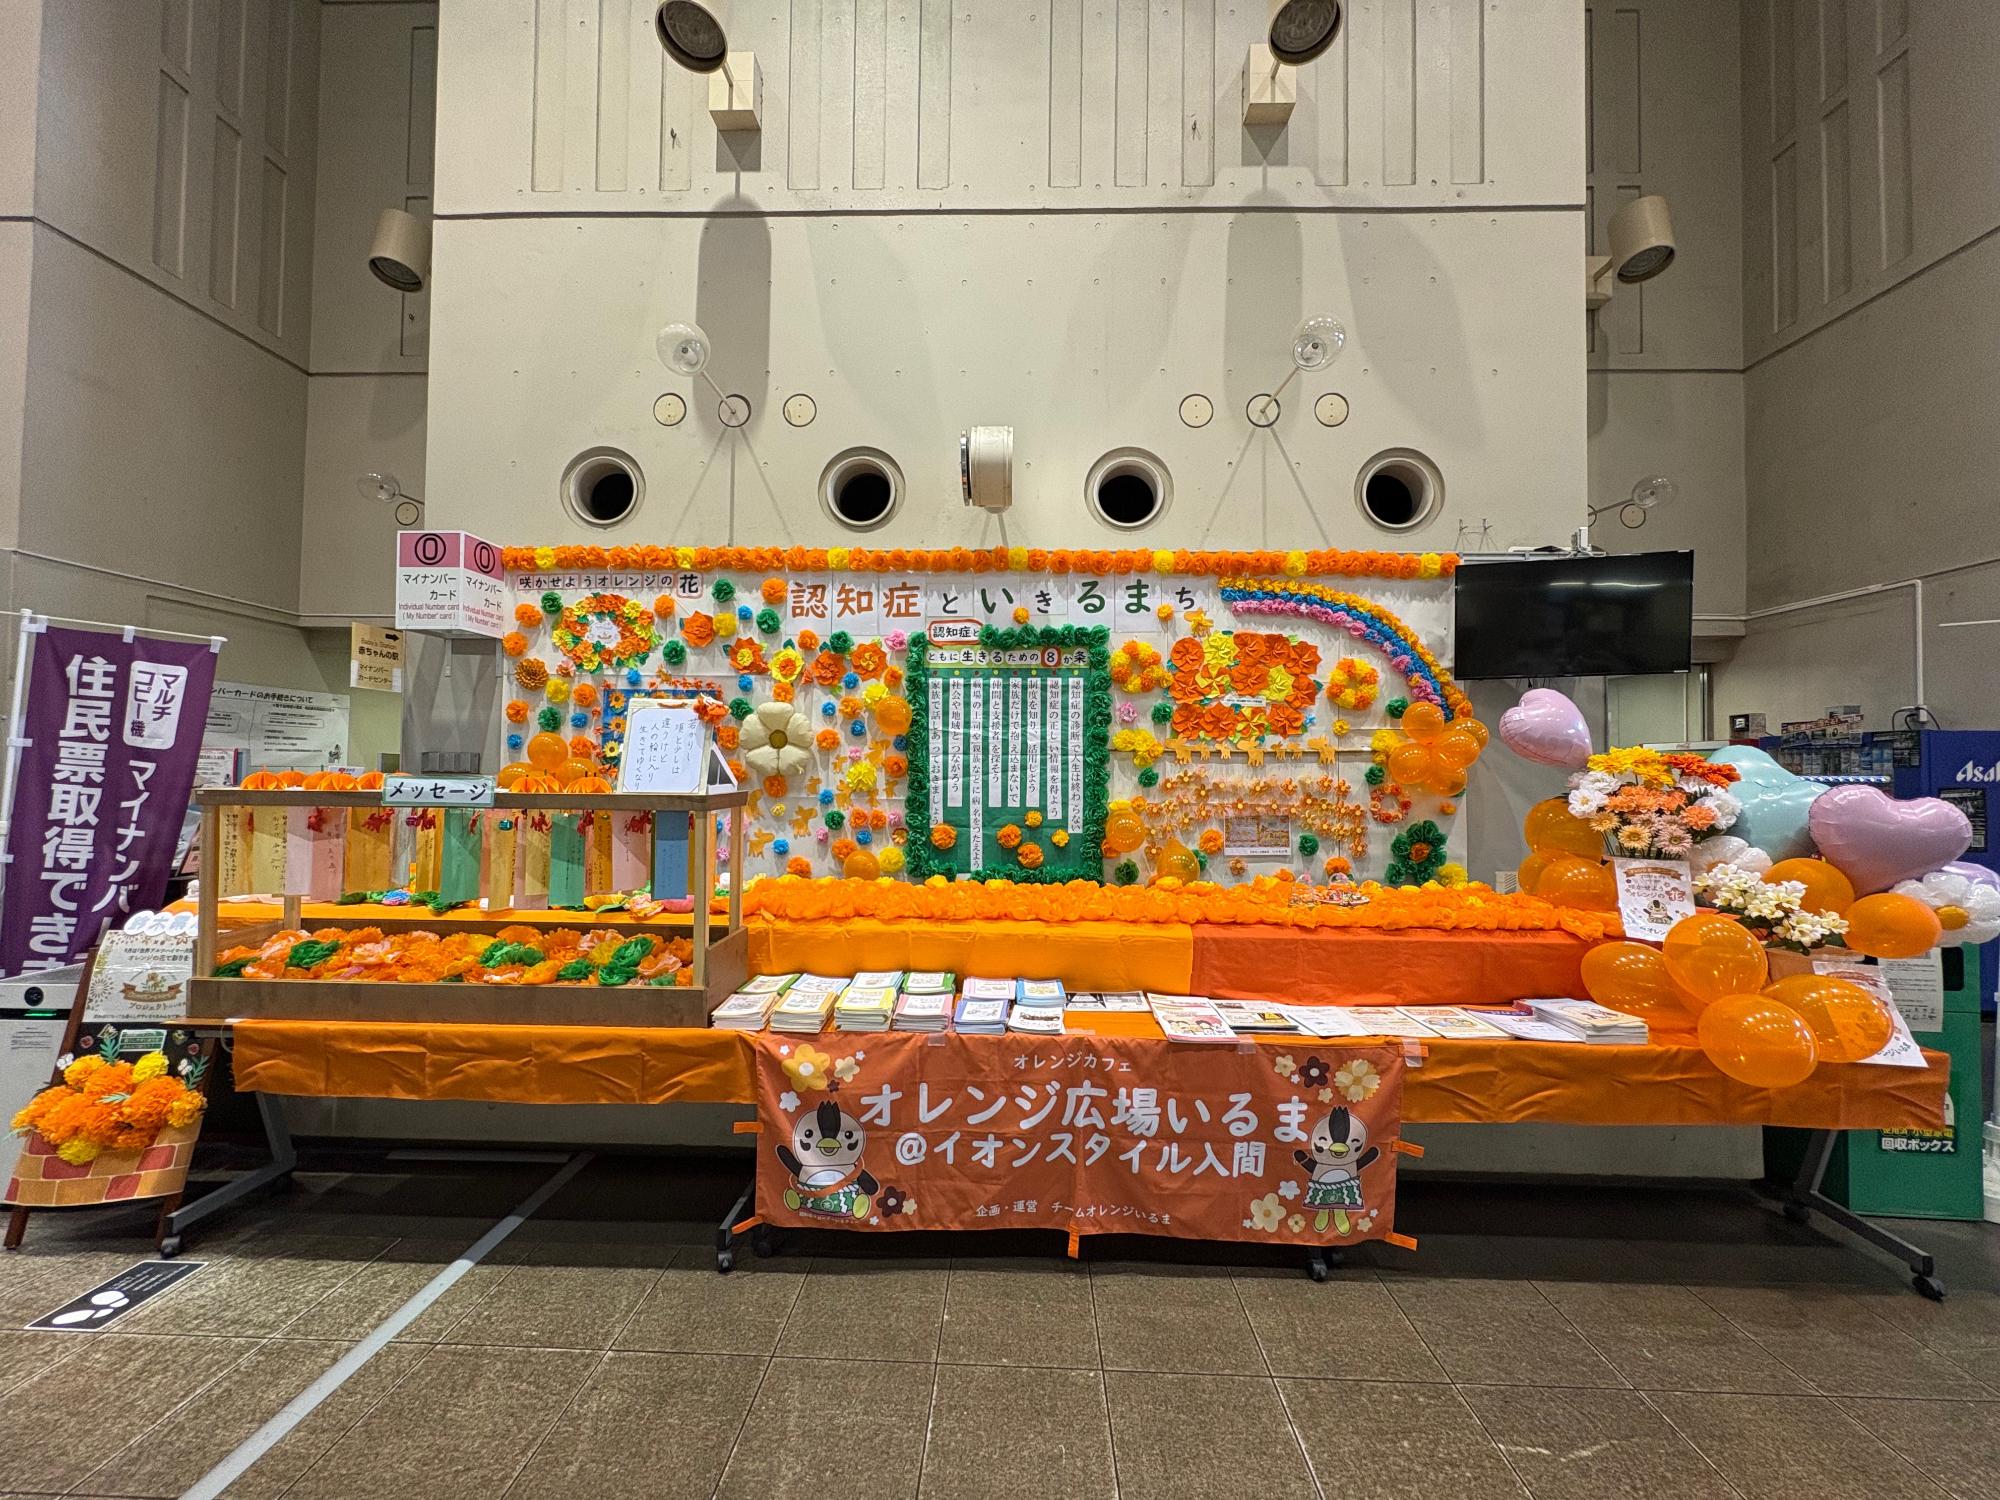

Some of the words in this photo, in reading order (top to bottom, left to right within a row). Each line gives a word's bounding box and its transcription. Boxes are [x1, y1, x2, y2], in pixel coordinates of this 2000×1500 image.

[403, 574, 457, 585] マイナンバー
[466, 576, 502, 594] マイナンバー
[519, 574, 699, 594] 咲かせようオレンジの花
[430, 590, 456, 601] カード
[484, 598, 502, 611] カード
[791, 579, 1197, 618] 認知症といきるまち
[933, 626, 978, 639] 認知症と
[359, 646, 399, 661] 赤ちゃんの駅
[928, 650, 1087, 663] ともに生きるための8か条
[130, 669, 155, 738] コピー機
[152, 673, 180, 722] マルチ
[951, 681, 962, 793] 社会や地域とつながろう
[389, 781, 488, 801] メッセージ
[1014, 1051, 1132, 1072] オレンジカフェ
[860, 1080, 1309, 1142] オレンジ広場いるま
[896, 1131, 1267, 1178] @イオンスタイル入間
[1881, 1137, 1955, 1152] 回収ボックス
[975, 1200, 1038, 1217] 企画・運営
[1051, 1201, 1172, 1225] チームオレンジいるま
